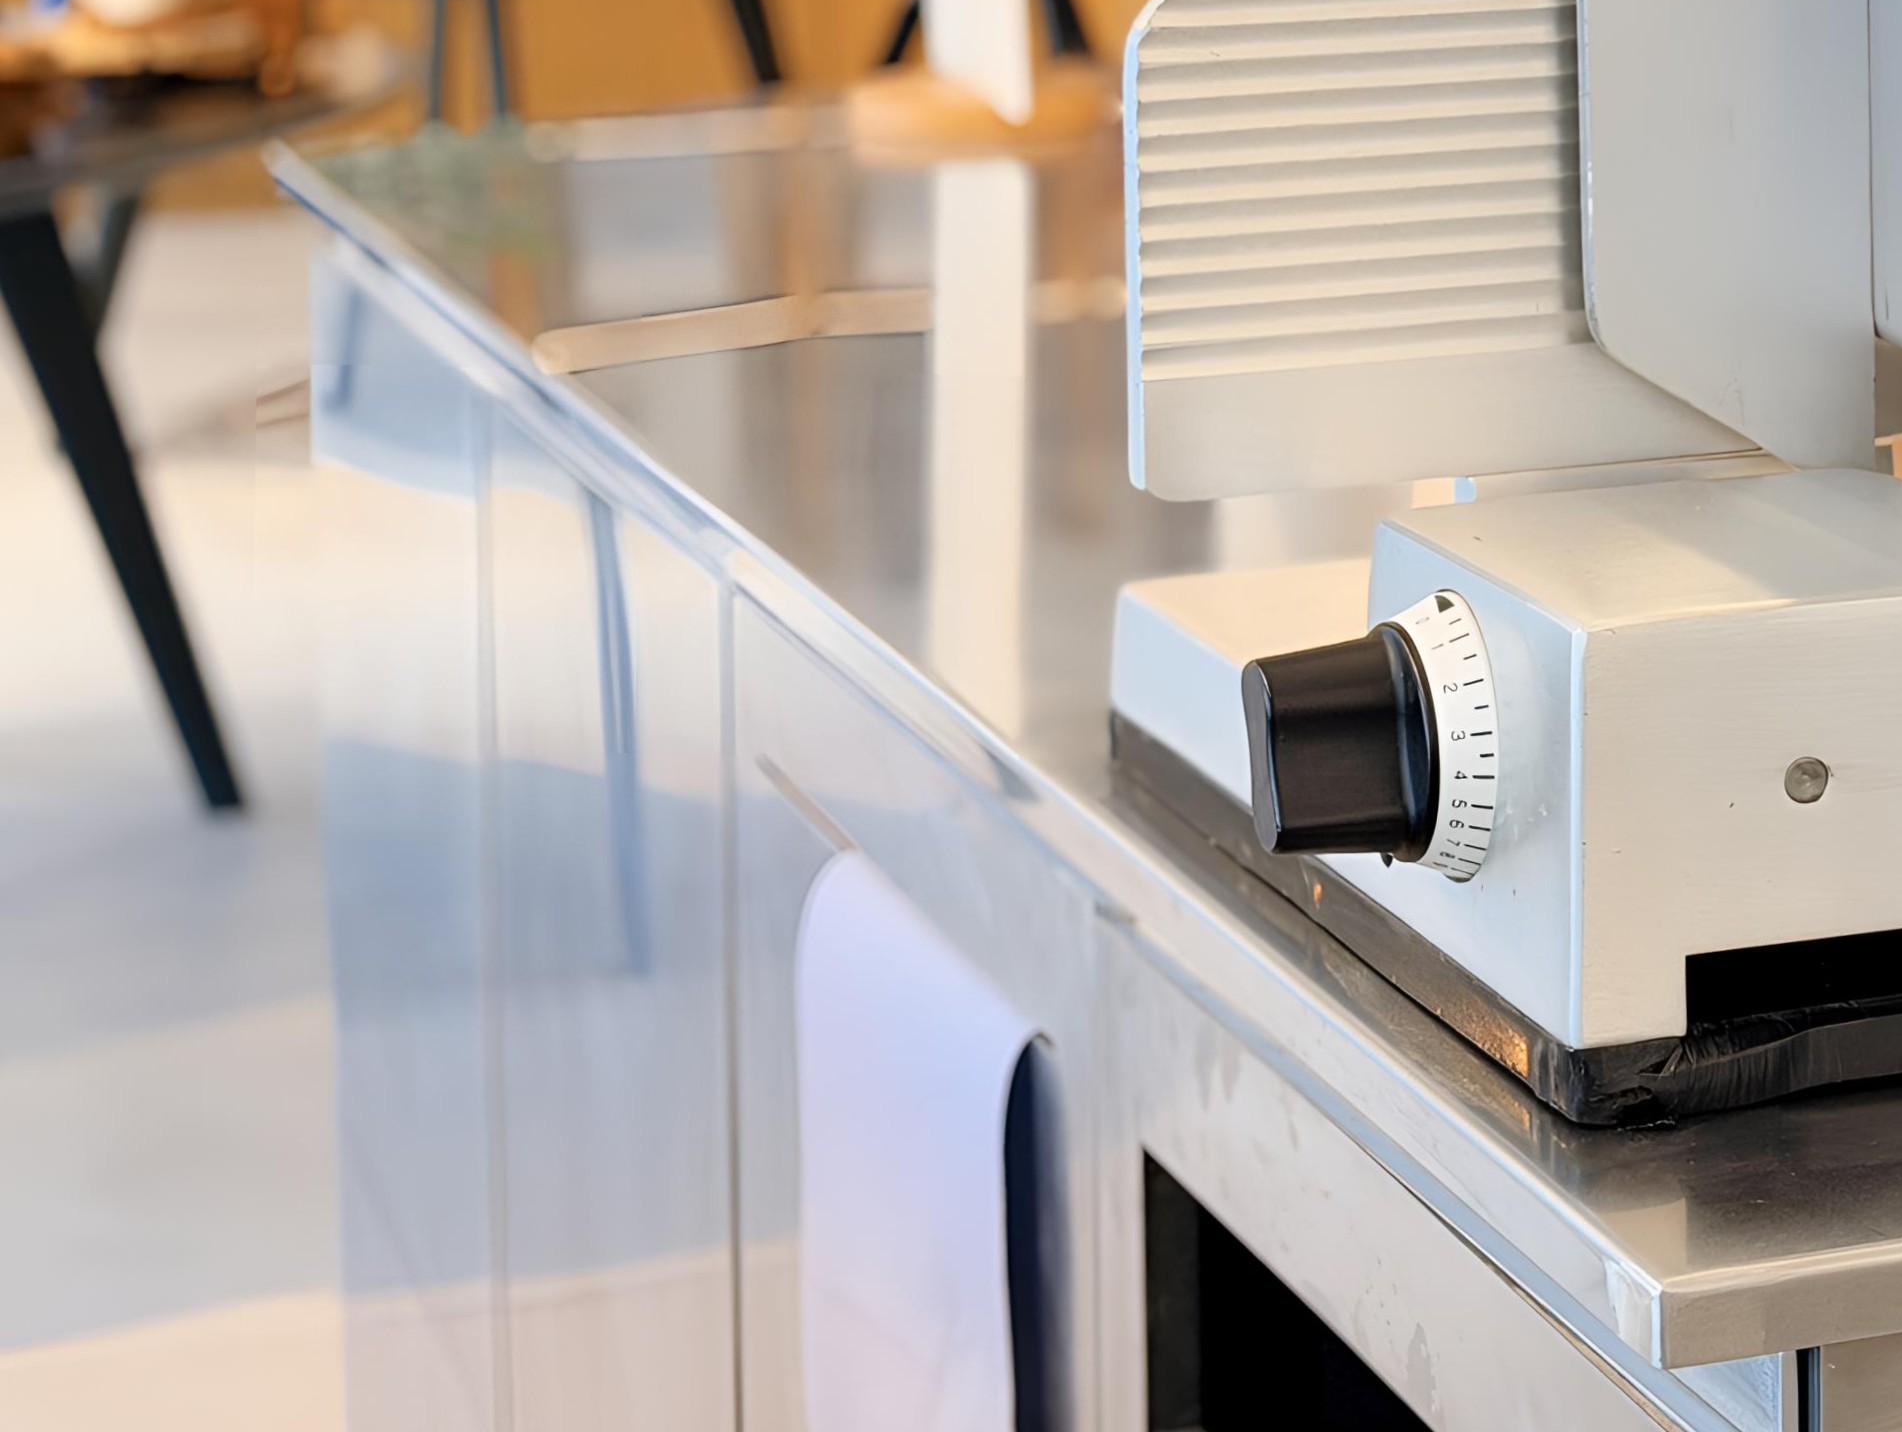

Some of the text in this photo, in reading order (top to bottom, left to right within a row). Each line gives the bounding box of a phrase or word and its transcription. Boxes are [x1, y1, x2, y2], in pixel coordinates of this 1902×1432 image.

[1443, 682, 1458, 694] 2
[1451, 730, 1466, 742] 3
[1454, 770, 1468, 780] 4
[1451, 799, 1467, 809] 5
[1449, 819, 1465, 829] 6
[1446, 838, 1461, 847] 7
